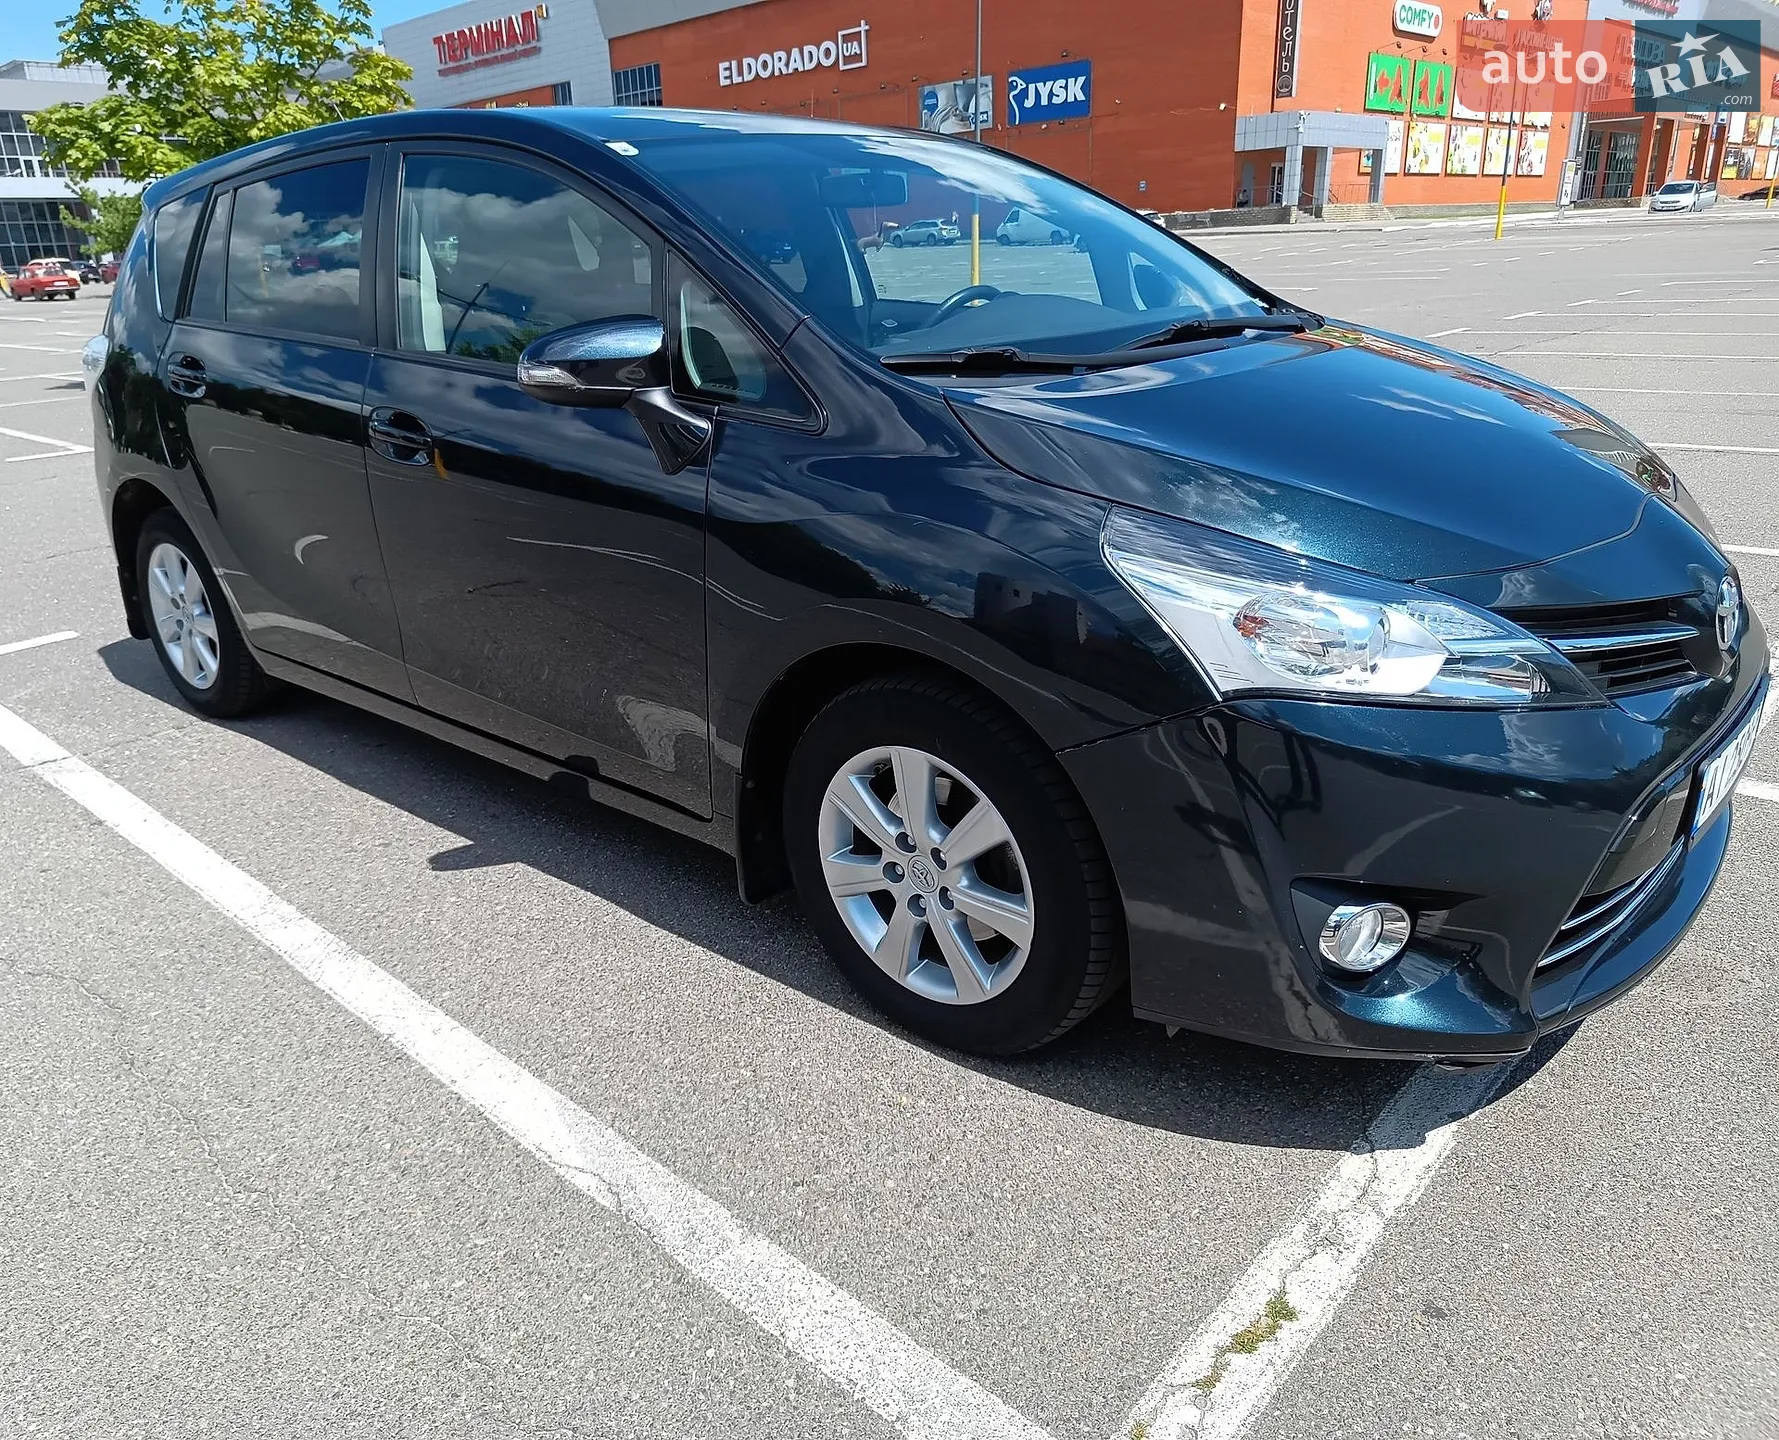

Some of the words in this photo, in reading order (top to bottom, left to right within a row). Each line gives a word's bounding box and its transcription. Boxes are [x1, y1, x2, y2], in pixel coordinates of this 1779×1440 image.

[1399, 4, 1434, 29] COMFY
[719, 40, 837, 87] ELDORADO
[842, 41, 861, 56] UA
[1024, 76, 1087, 108] JYSK
